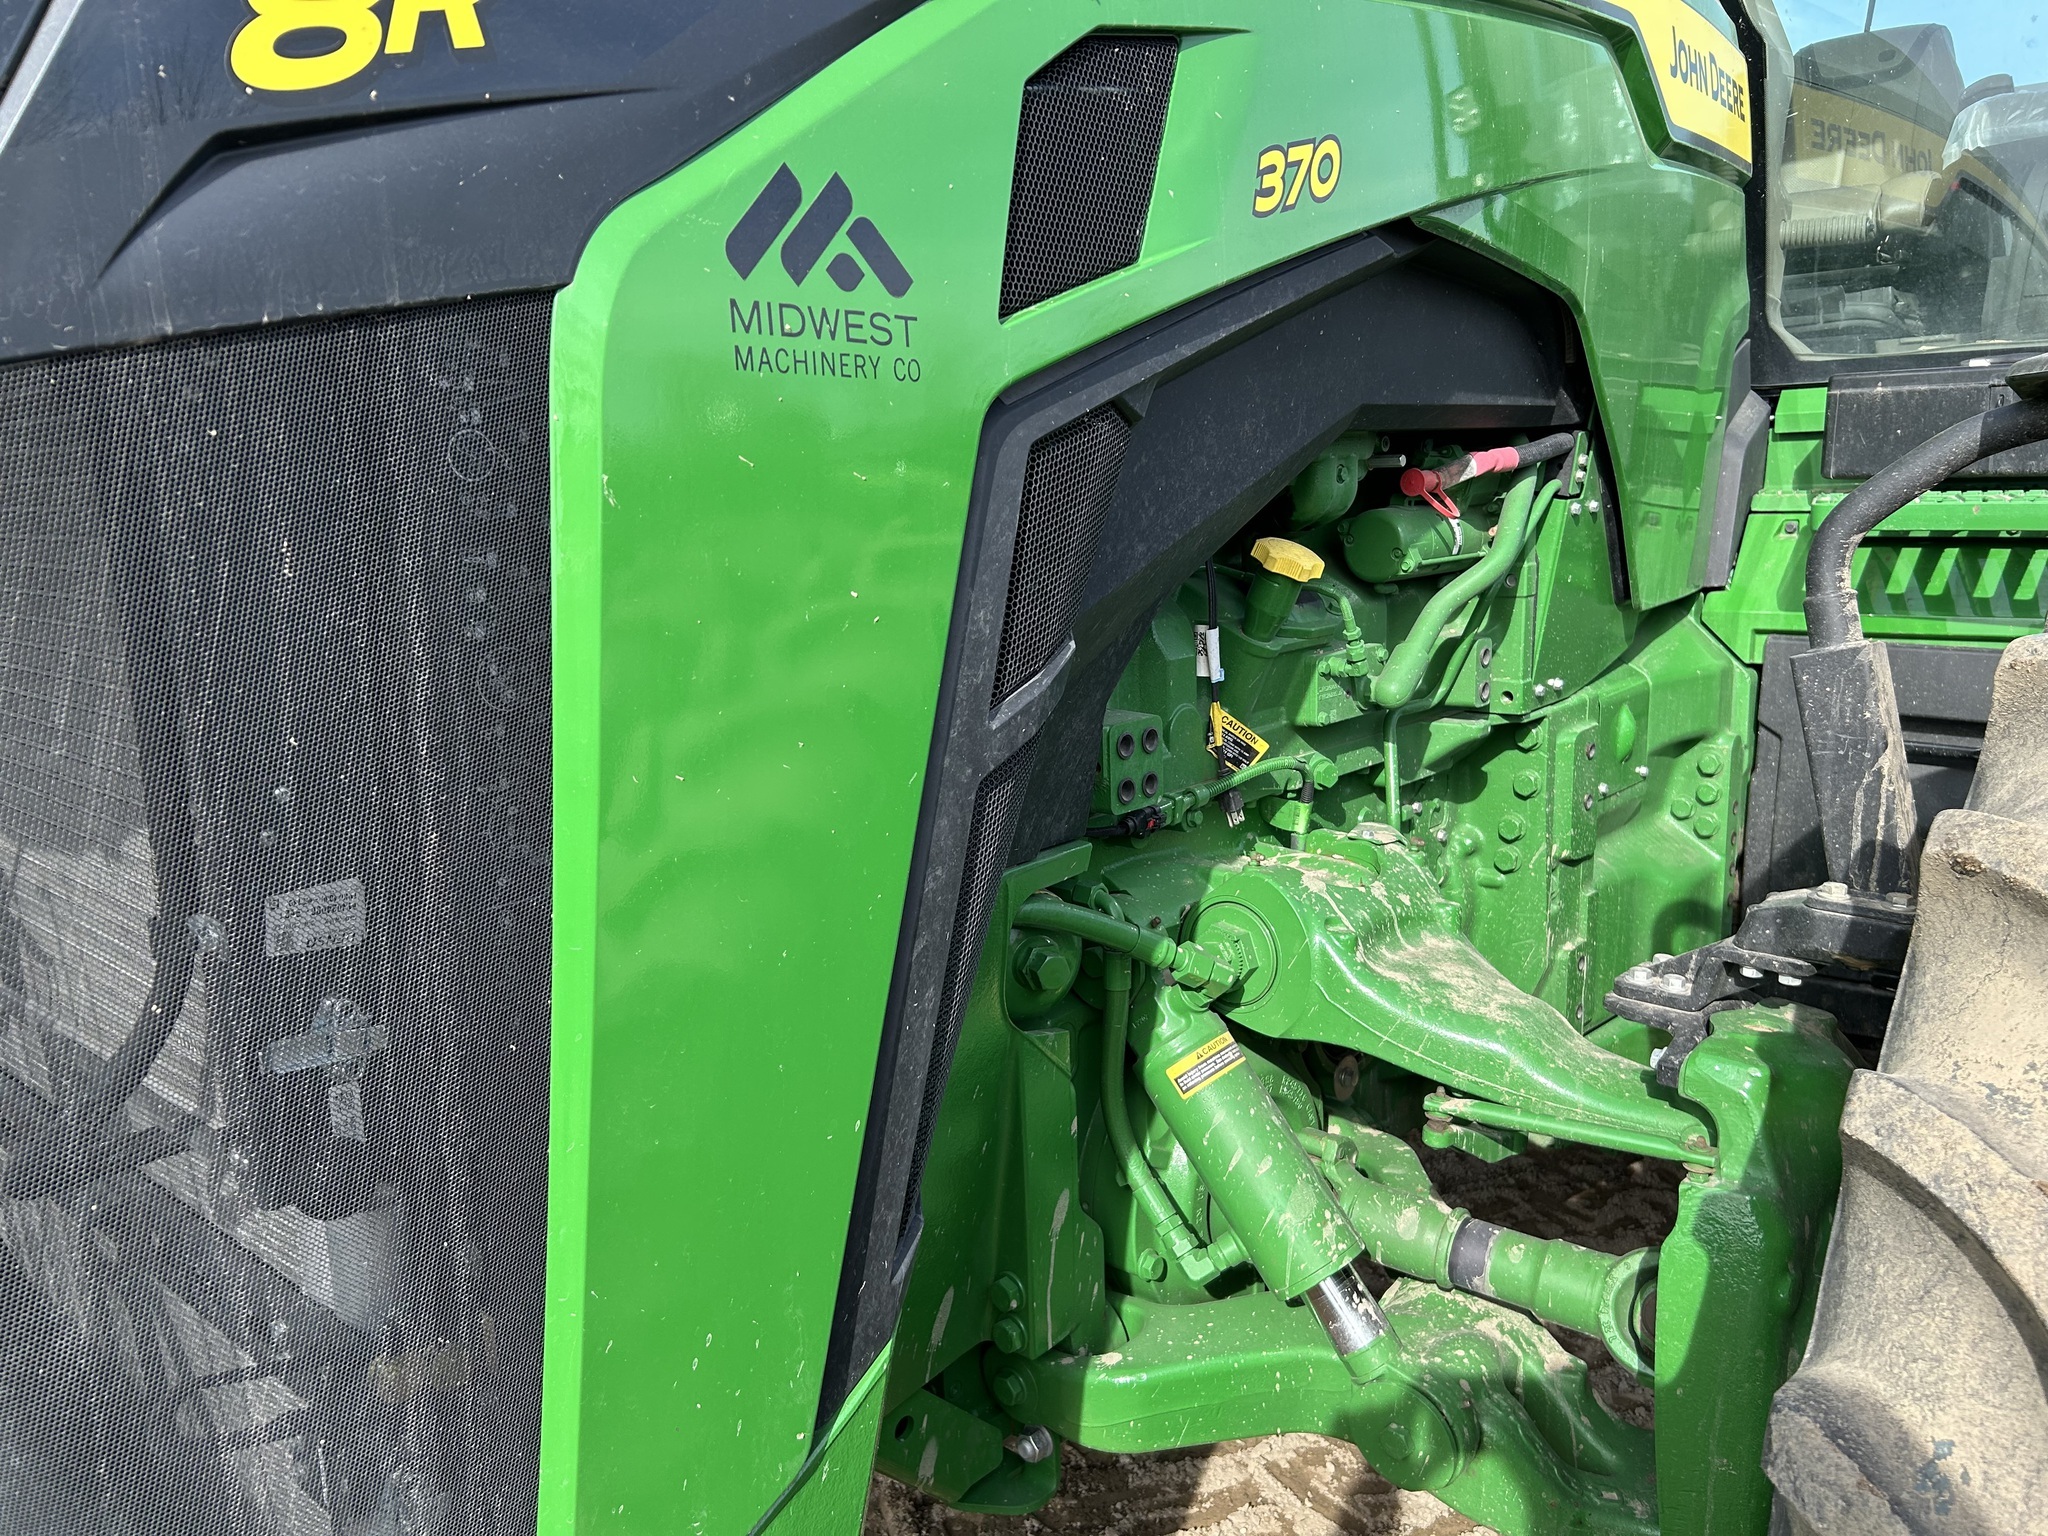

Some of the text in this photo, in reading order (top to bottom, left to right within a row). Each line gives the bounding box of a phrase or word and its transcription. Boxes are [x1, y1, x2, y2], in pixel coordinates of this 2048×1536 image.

[1670, 25, 1746, 123] JOHN DEERE
[1252, 134, 1342, 218] 370
[729, 298, 918, 347] MIDWEST
[734, 345, 921, 383] MACHINERY CO
[1222, 716, 1259, 745] CAUTION
[1202, 1036, 1228, 1055] CAUTION
